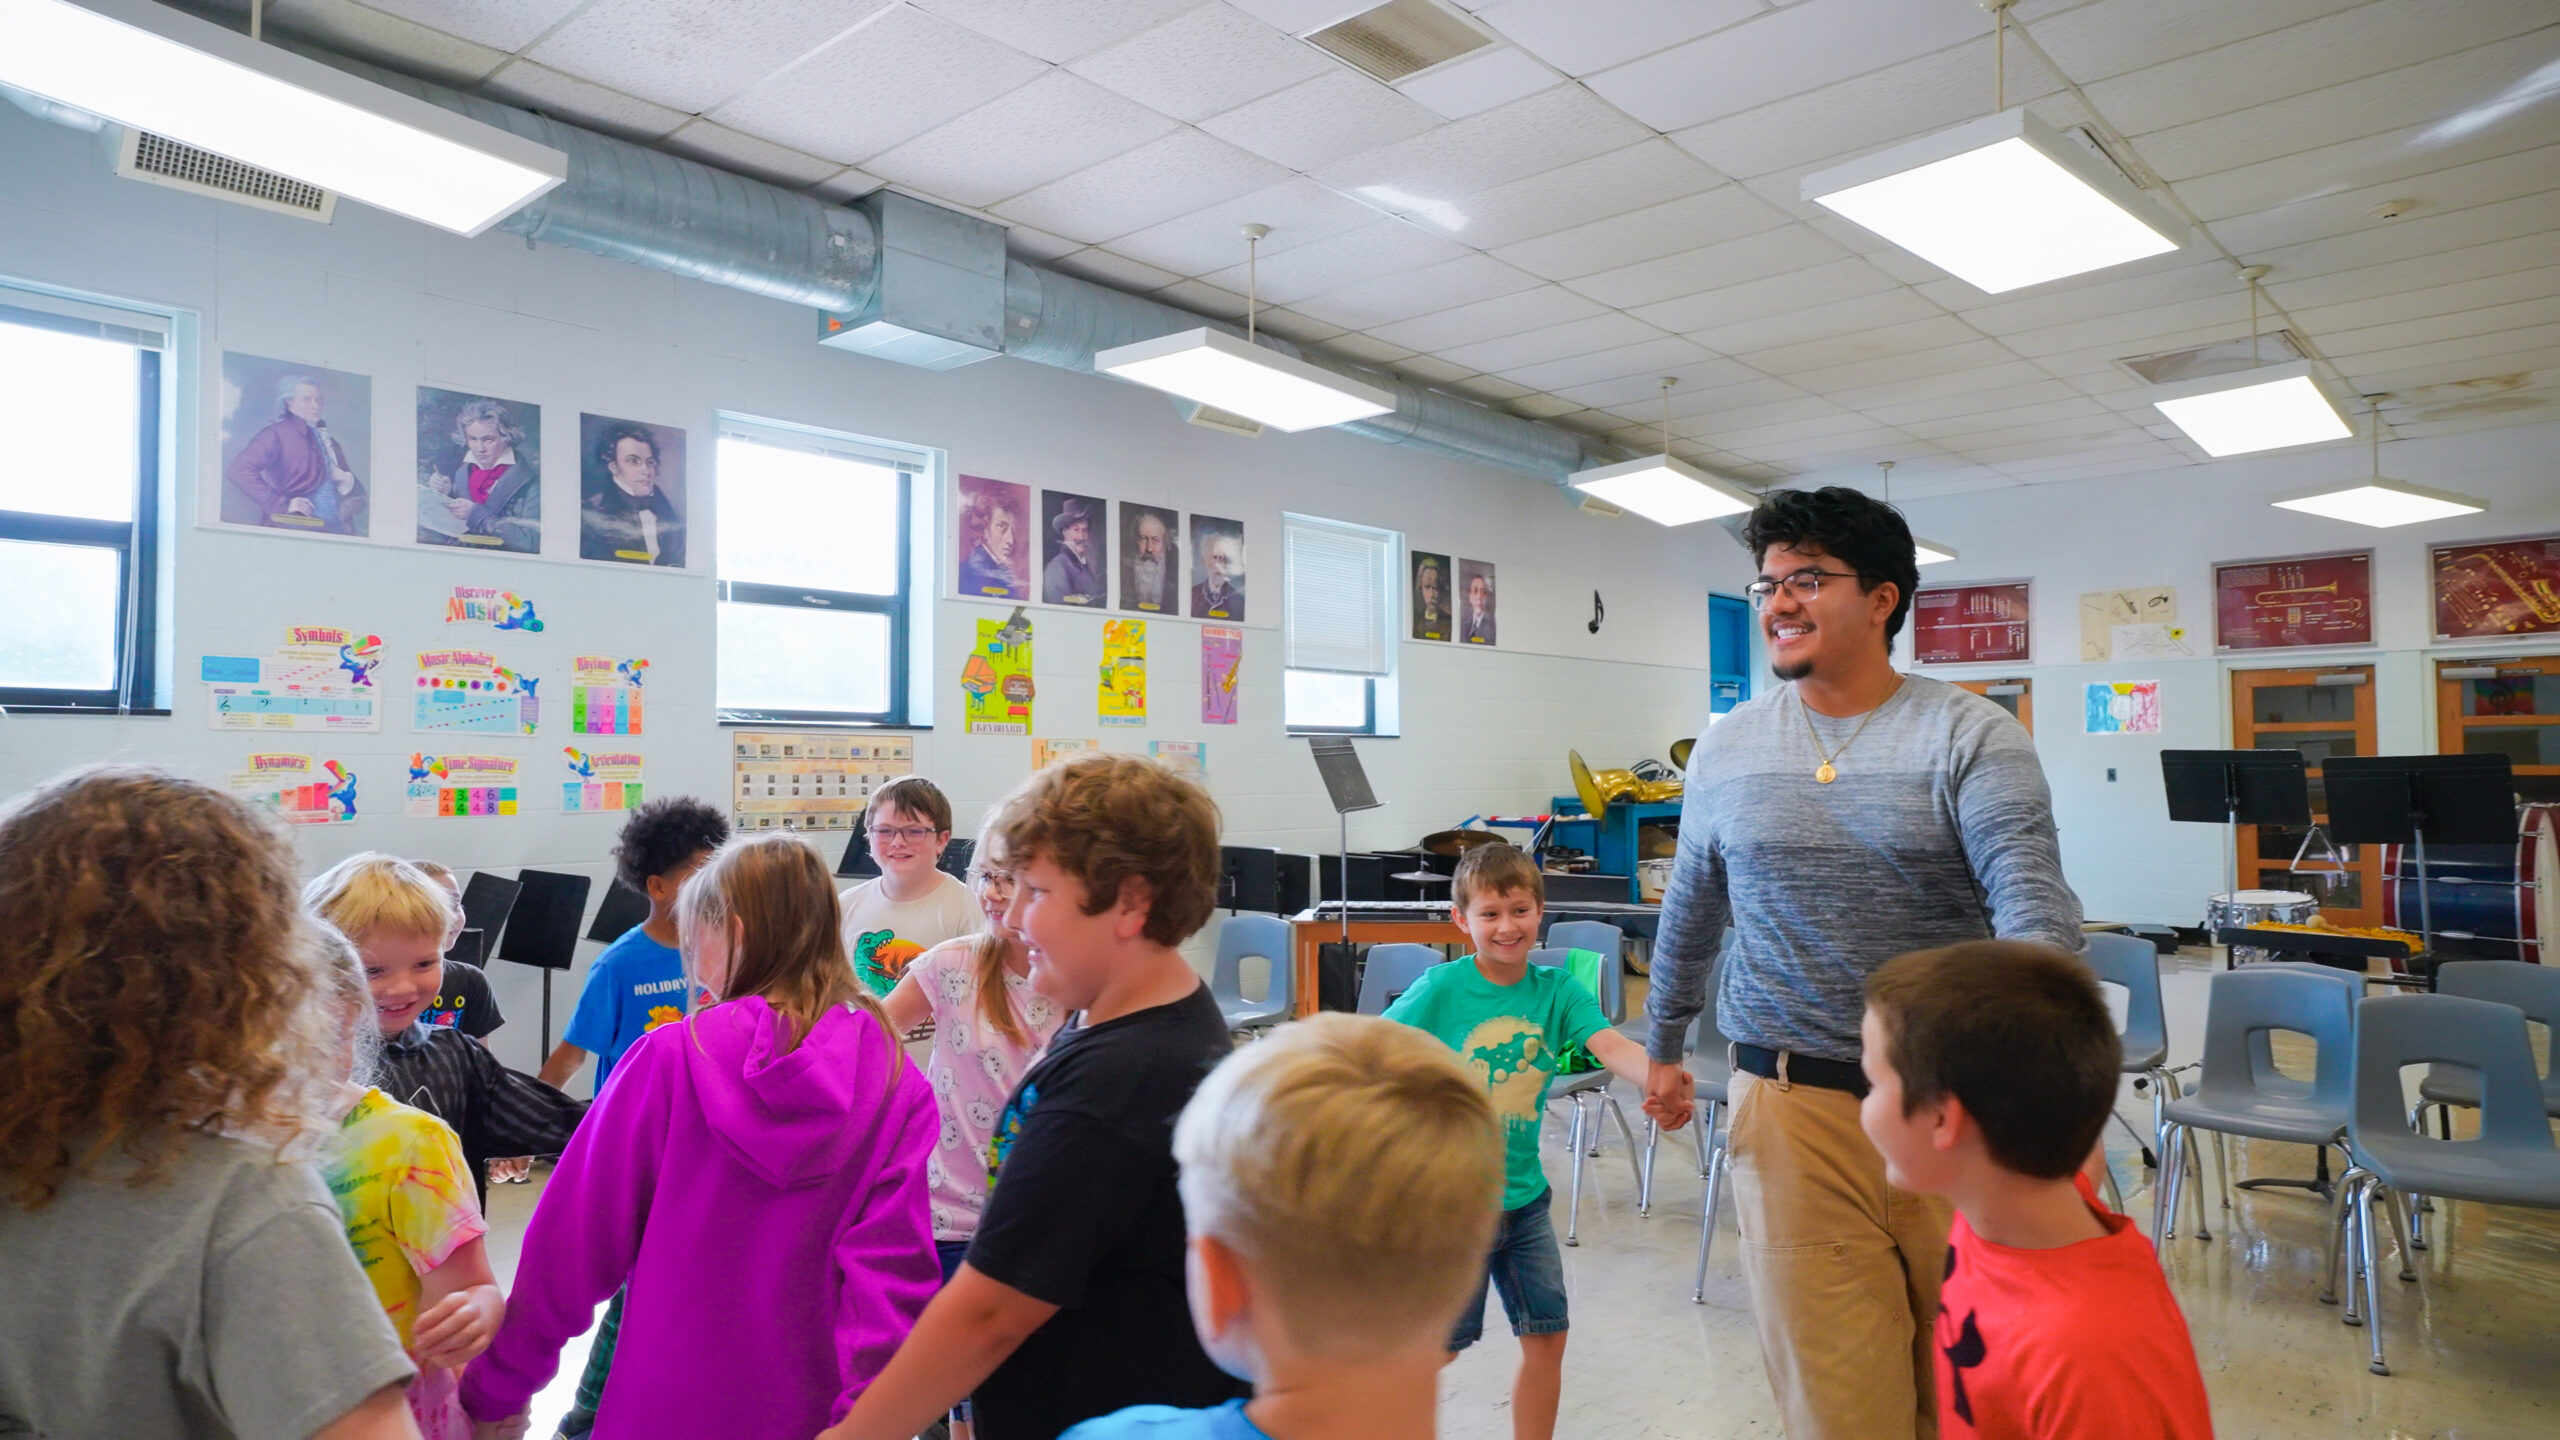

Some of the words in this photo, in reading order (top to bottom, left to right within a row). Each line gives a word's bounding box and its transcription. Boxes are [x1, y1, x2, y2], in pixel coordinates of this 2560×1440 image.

[455, 586, 497, 599] Discover
[446, 597, 502, 622] Music
[294, 627, 343, 646] Symbols
[421, 653, 450, 668] Music
[452, 651, 494, 668] Alphabet
[976, 723, 1022, 734] KEYBOARD
[254, 755, 306, 772] Dynamics
[442, 756, 467, 770] Time
[468, 755, 515, 772] Signature
[443, 790, 450, 801] 2
[457, 789, 465, 800] 3
[473, 790, 480, 799] 4
[487, 789, 495, 800] 6
[442, 803, 450, 813] 4
[457, 803, 465, 813] 4
[473, 802, 480, 812] 4
[487, 802, 495, 813] 8
